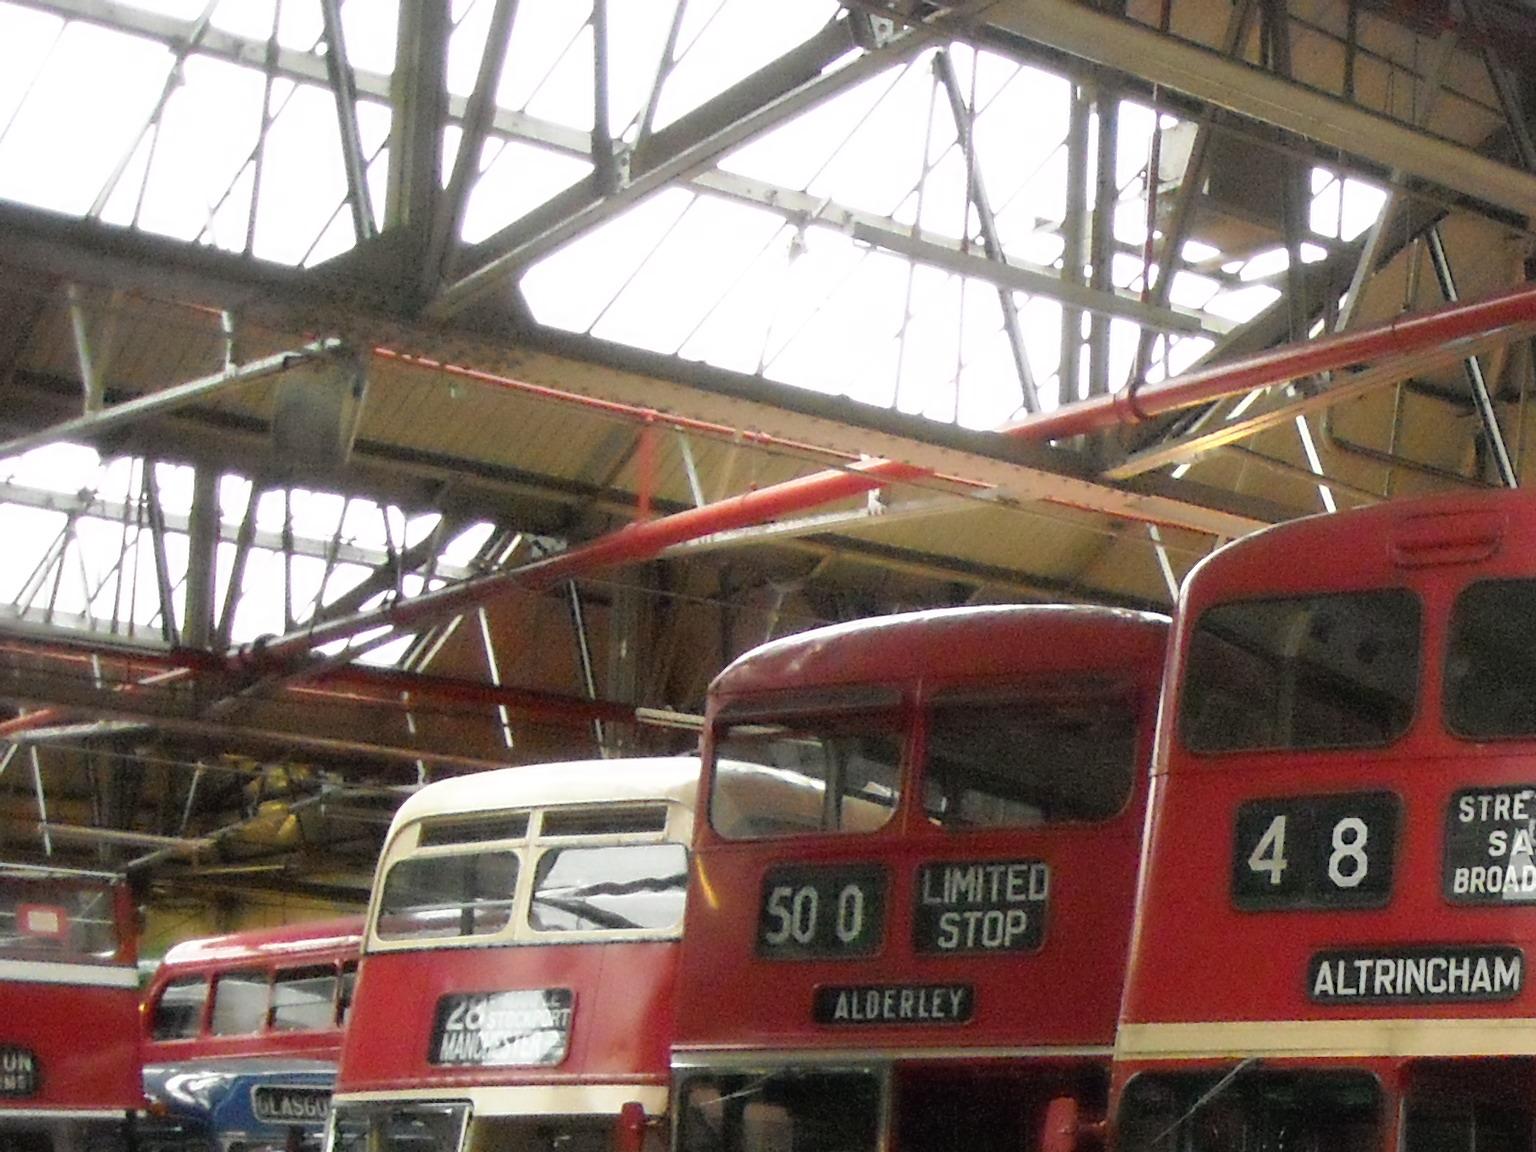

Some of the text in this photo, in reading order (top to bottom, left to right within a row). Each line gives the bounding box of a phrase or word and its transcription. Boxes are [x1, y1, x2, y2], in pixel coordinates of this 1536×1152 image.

[922, 863, 1050, 904] LIMITED
[937, 909, 1028, 949] STOP
[1313, 956, 1521, 997] ALTRINCHAM
[834, 988, 965, 1020] ALDERLEY
